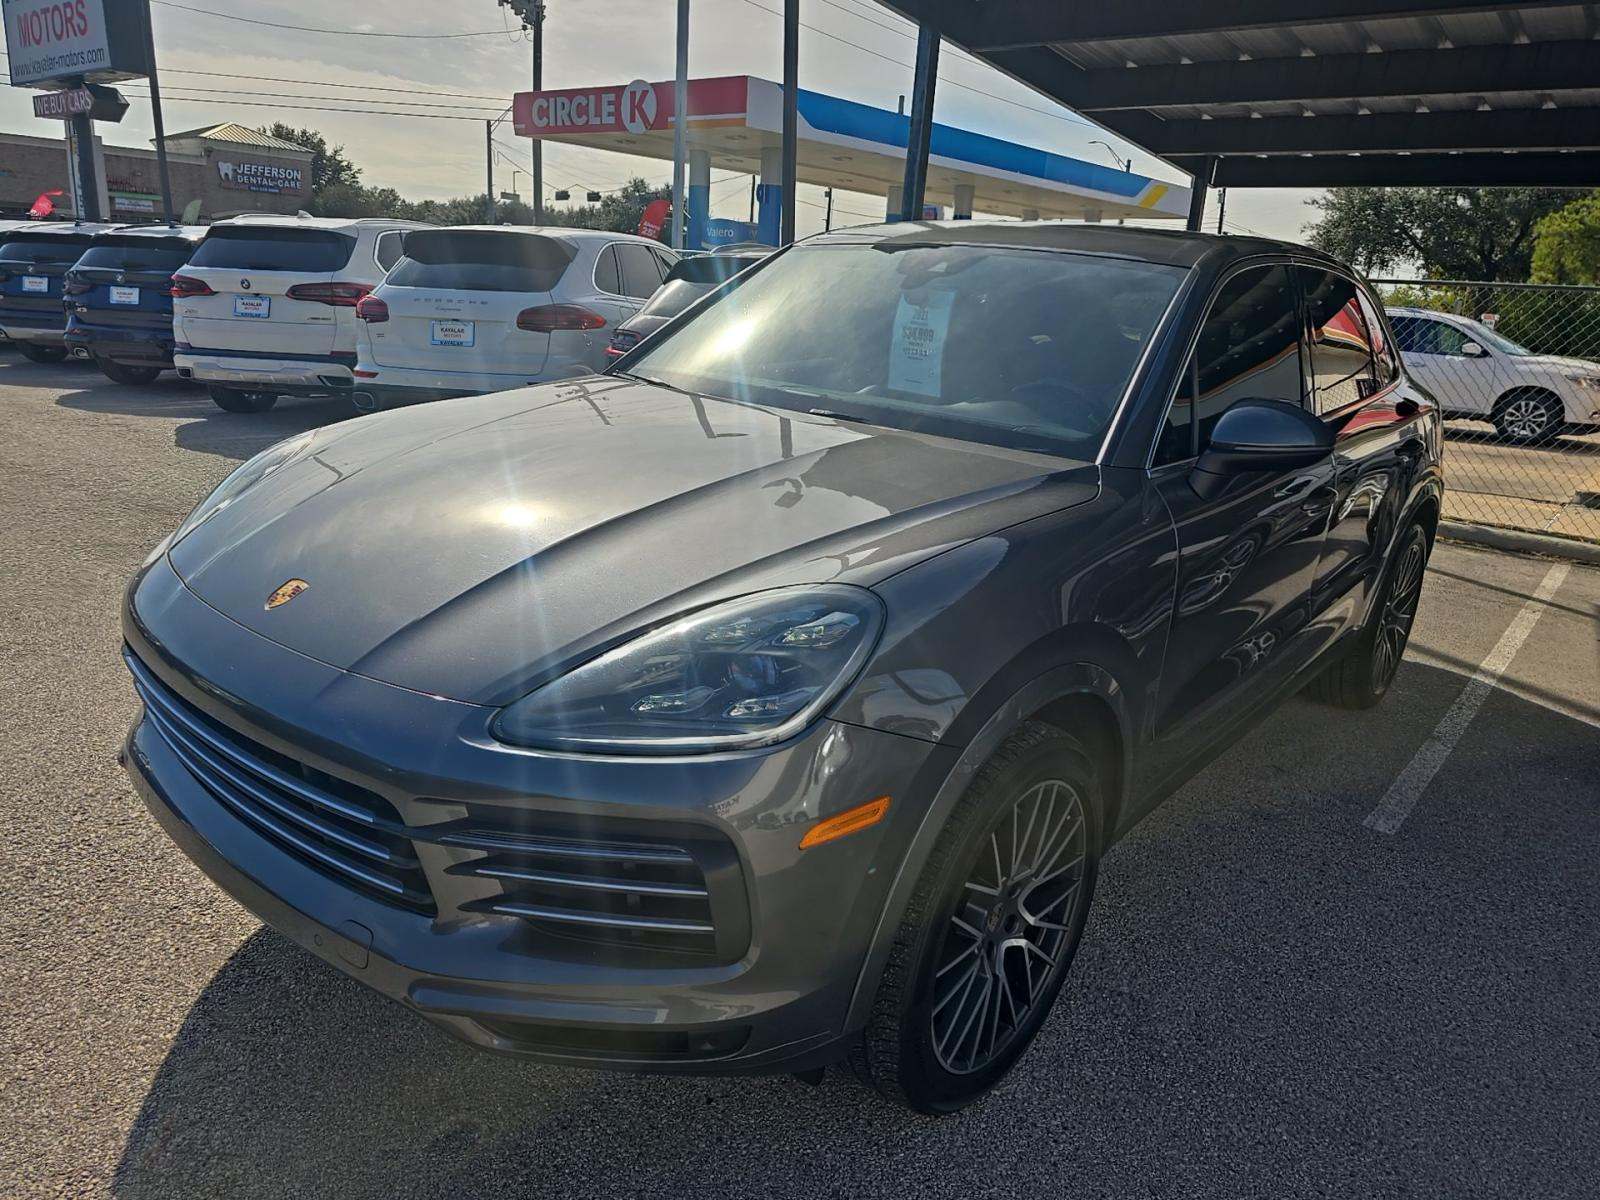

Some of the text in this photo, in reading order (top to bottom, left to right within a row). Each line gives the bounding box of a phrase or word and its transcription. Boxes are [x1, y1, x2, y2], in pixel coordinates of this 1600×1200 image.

[17, 0, 88, 48] MOTORS
[35, 89, 92, 115] WE BUY CARS
[532, 89, 652, 130] CIRCLE K
[236, 163, 302, 180] JEFFERSON
[237, 175, 274, 187] DENTAL
[277, 180, 302, 190] CARE
[706, 227, 734, 238] Valero
